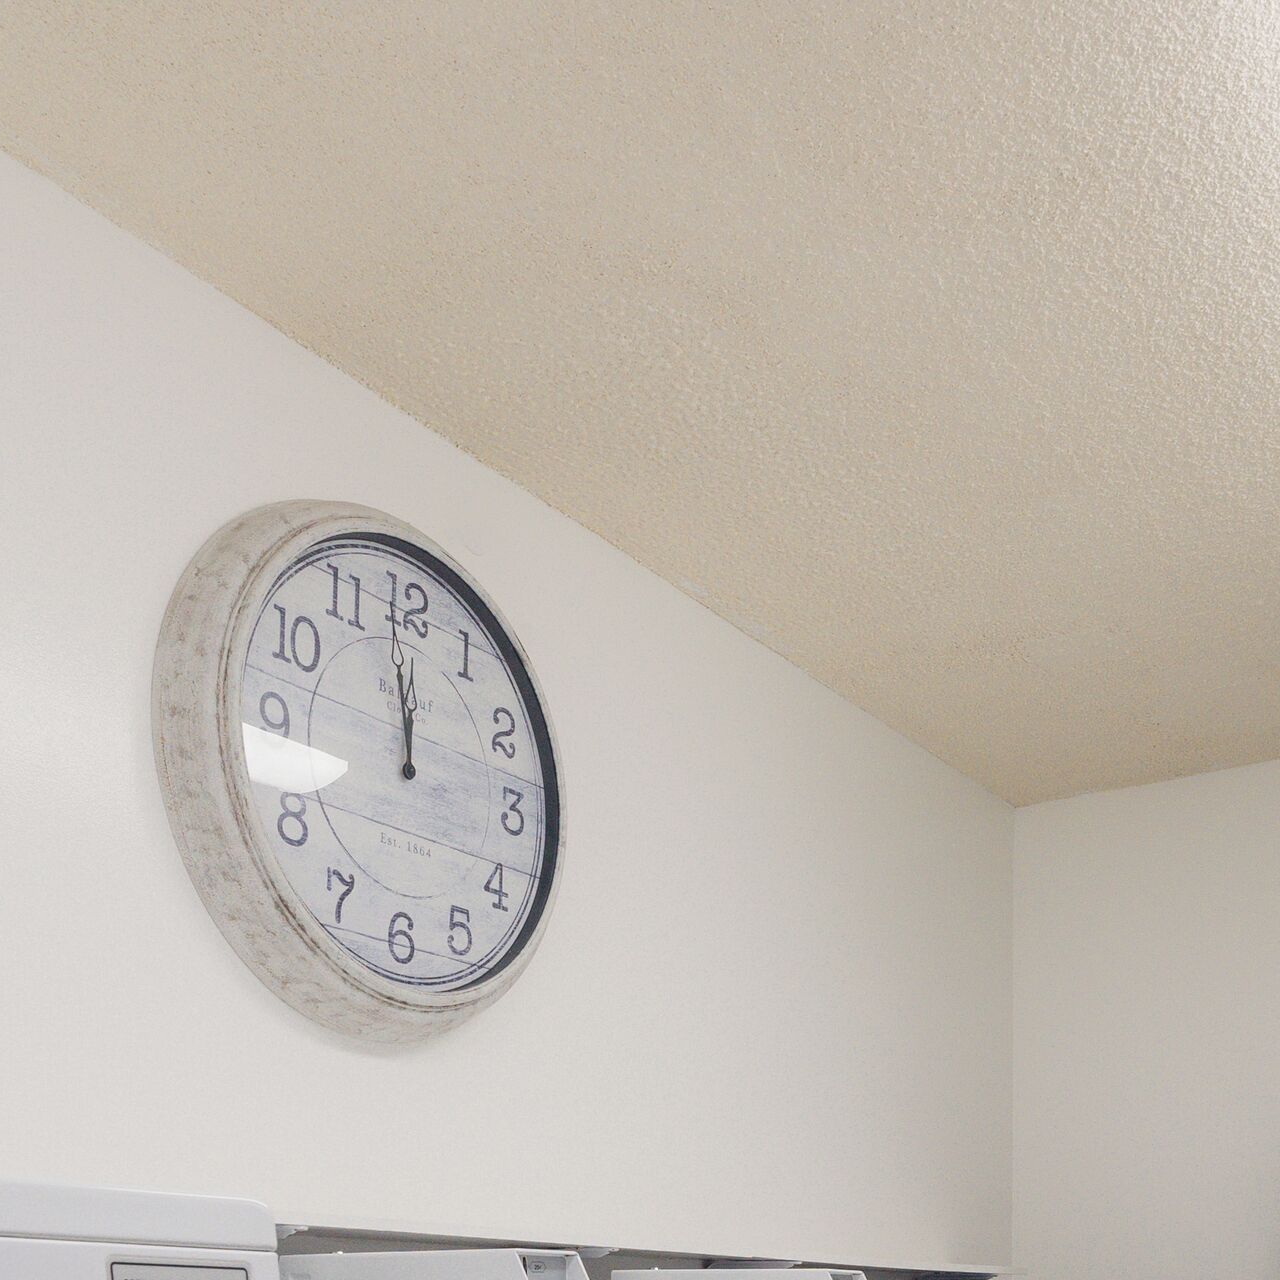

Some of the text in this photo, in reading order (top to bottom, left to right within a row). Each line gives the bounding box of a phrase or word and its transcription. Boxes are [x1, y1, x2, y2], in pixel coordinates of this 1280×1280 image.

[326, 562, 365, 631] 11
[385, 570, 428, 638] 12
[272, 604, 321, 672] 10
[457, 631, 473, 682] 1
[260, 691, 290, 738] 9
[491, 707, 515, 759] 2
[277, 793, 308, 847] 8
[500, 787, 524, 837] 3
[327, 866, 355, 923] 7
[483, 862, 509, 911] 4
[387, 911, 415, 963] 6
[447, 905, 472, 956] 5
